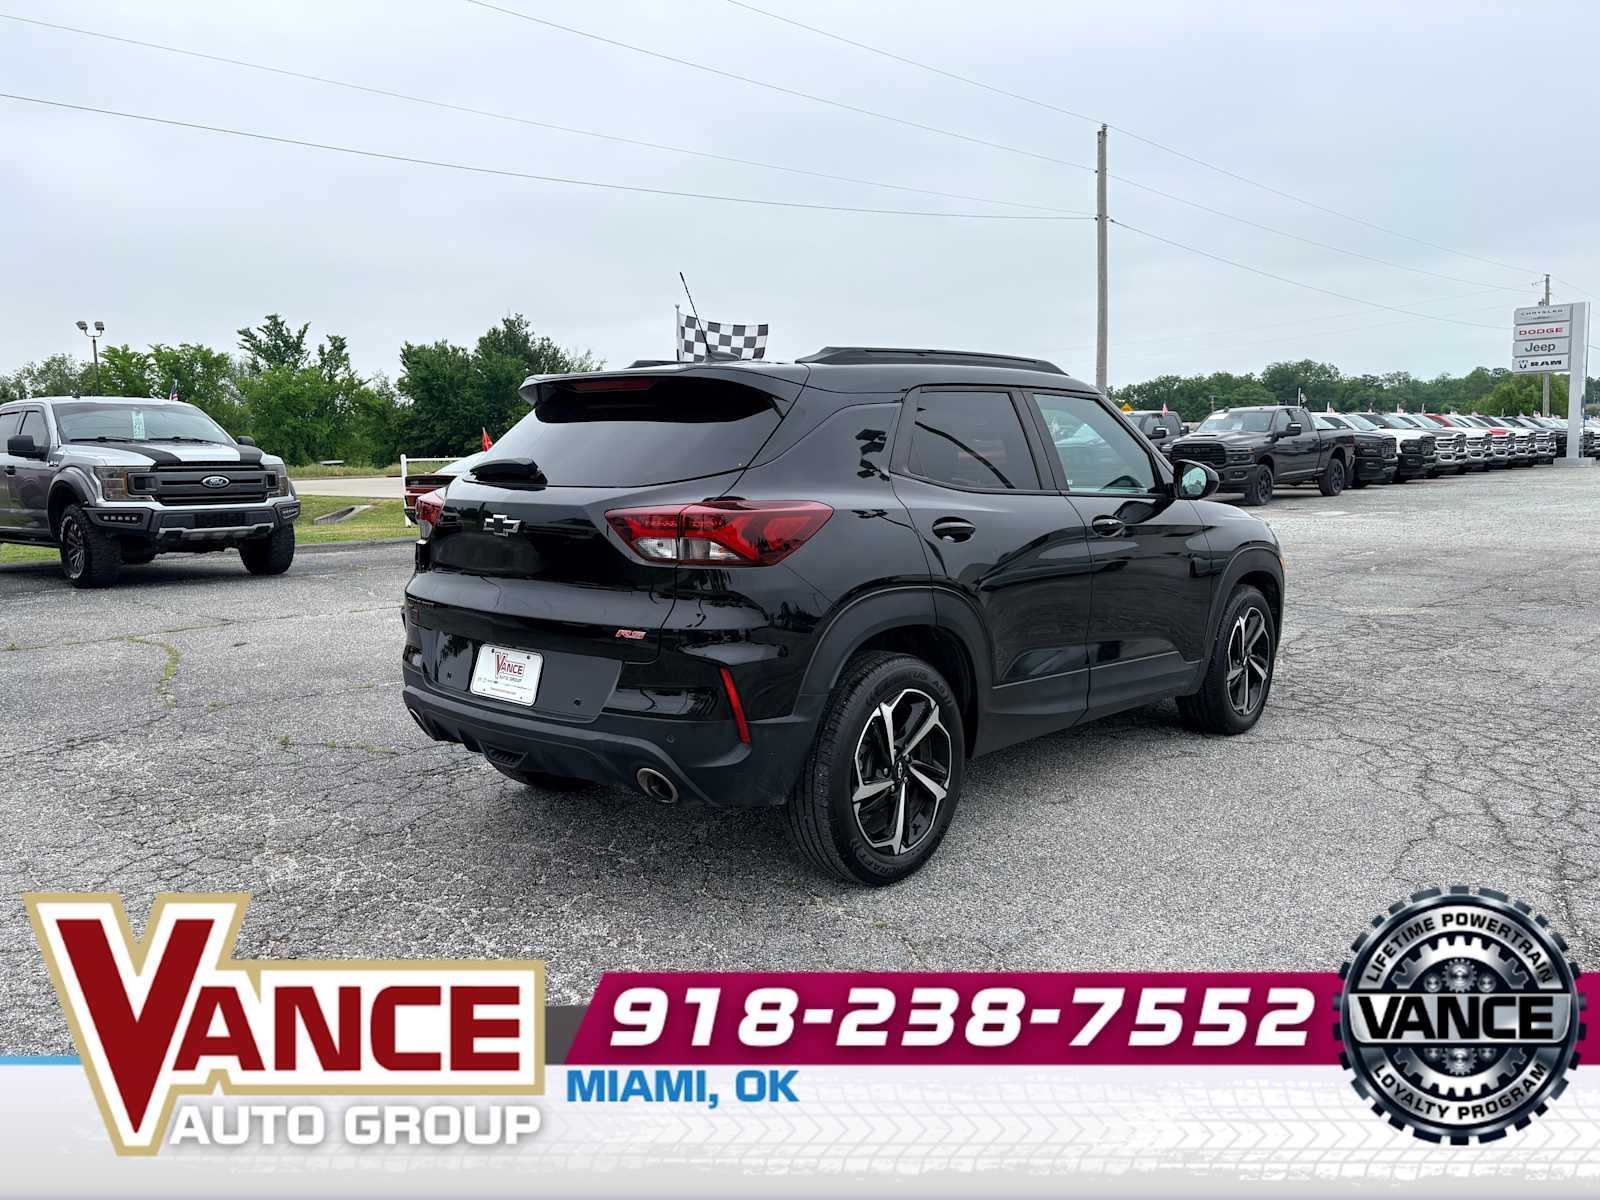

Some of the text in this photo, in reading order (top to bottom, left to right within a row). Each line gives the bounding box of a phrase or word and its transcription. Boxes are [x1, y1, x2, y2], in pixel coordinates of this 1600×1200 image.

[1520, 308, 1563, 316] CHRYSLER
[1519, 327, 1563, 336] DODGE
[1524, 342, 1556, 353] Jeep
[1530, 359, 1562, 367] RAM
[615, 629, 647, 640] RS
[495, 653, 524, 676] VANCE
